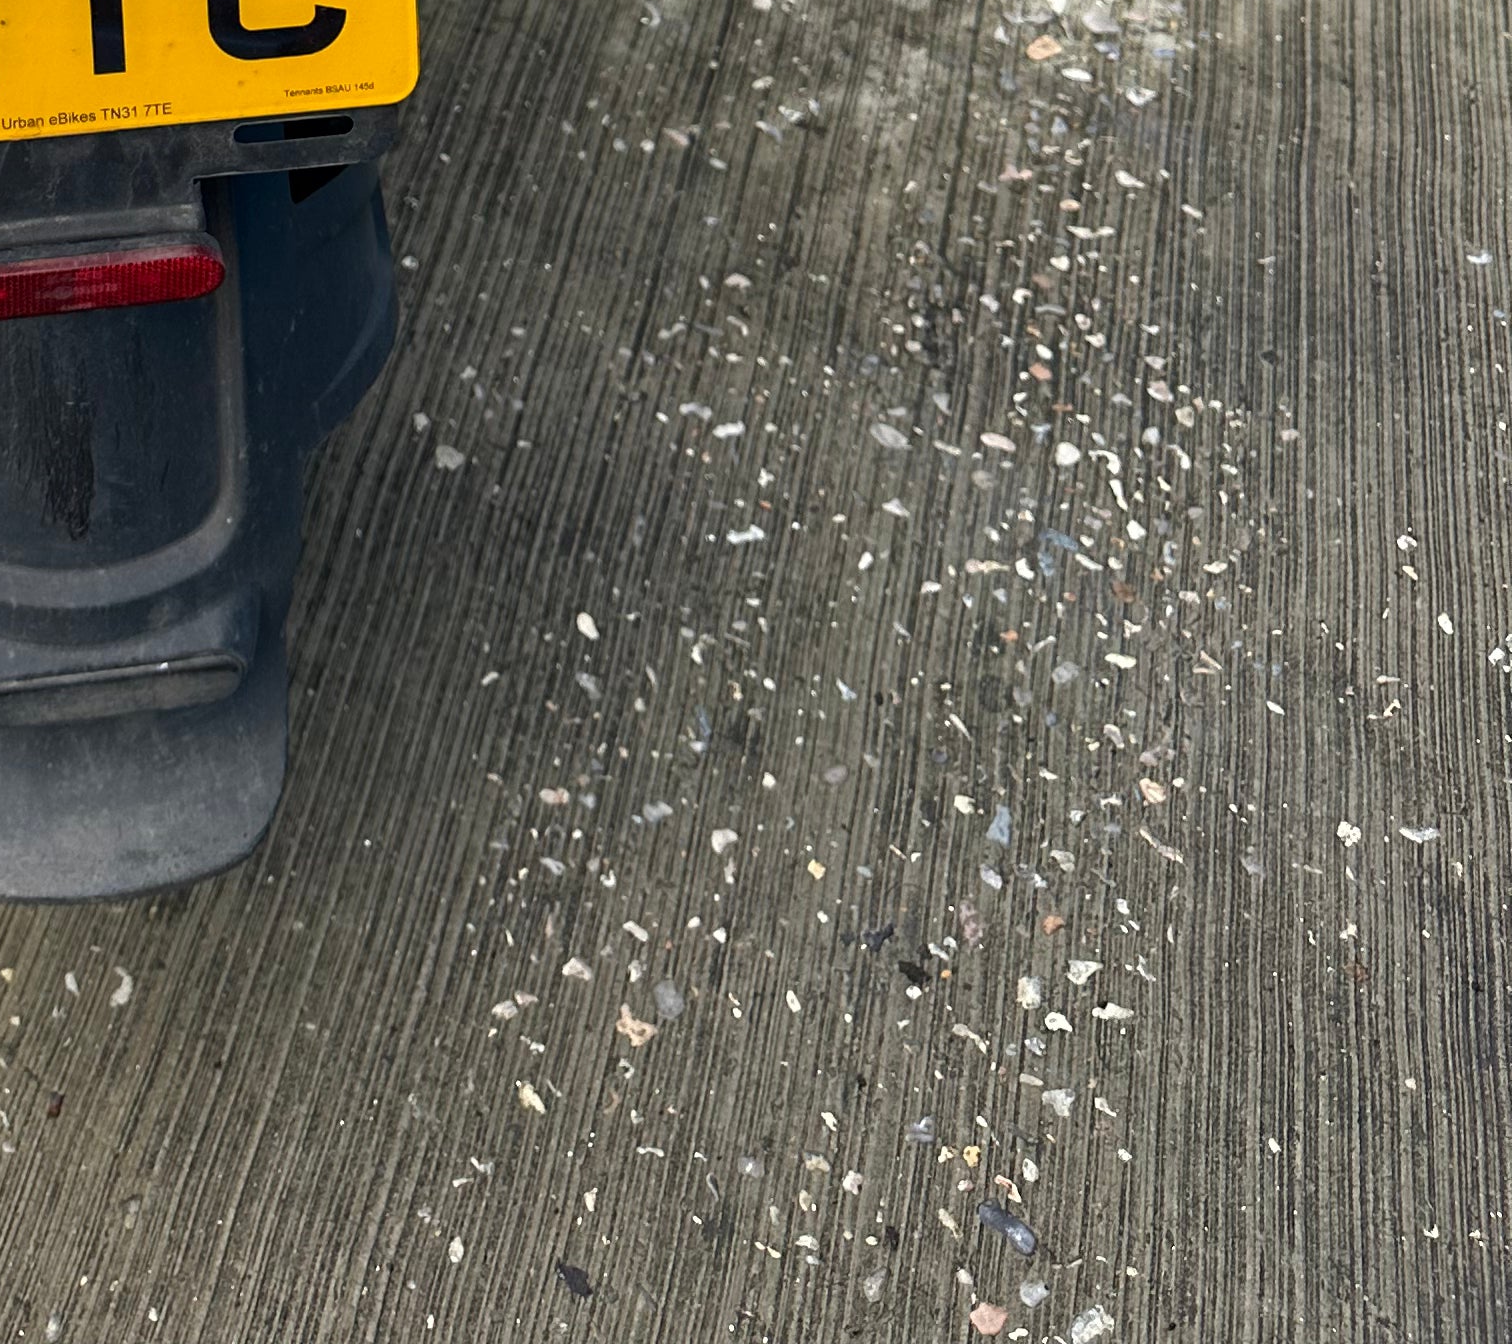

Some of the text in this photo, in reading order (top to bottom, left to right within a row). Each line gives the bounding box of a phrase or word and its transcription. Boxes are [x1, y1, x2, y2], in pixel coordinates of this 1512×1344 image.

[284, 87, 324, 98] Tennants
[1, 102, 173, 130] Urban eBikes TN31 7TE
